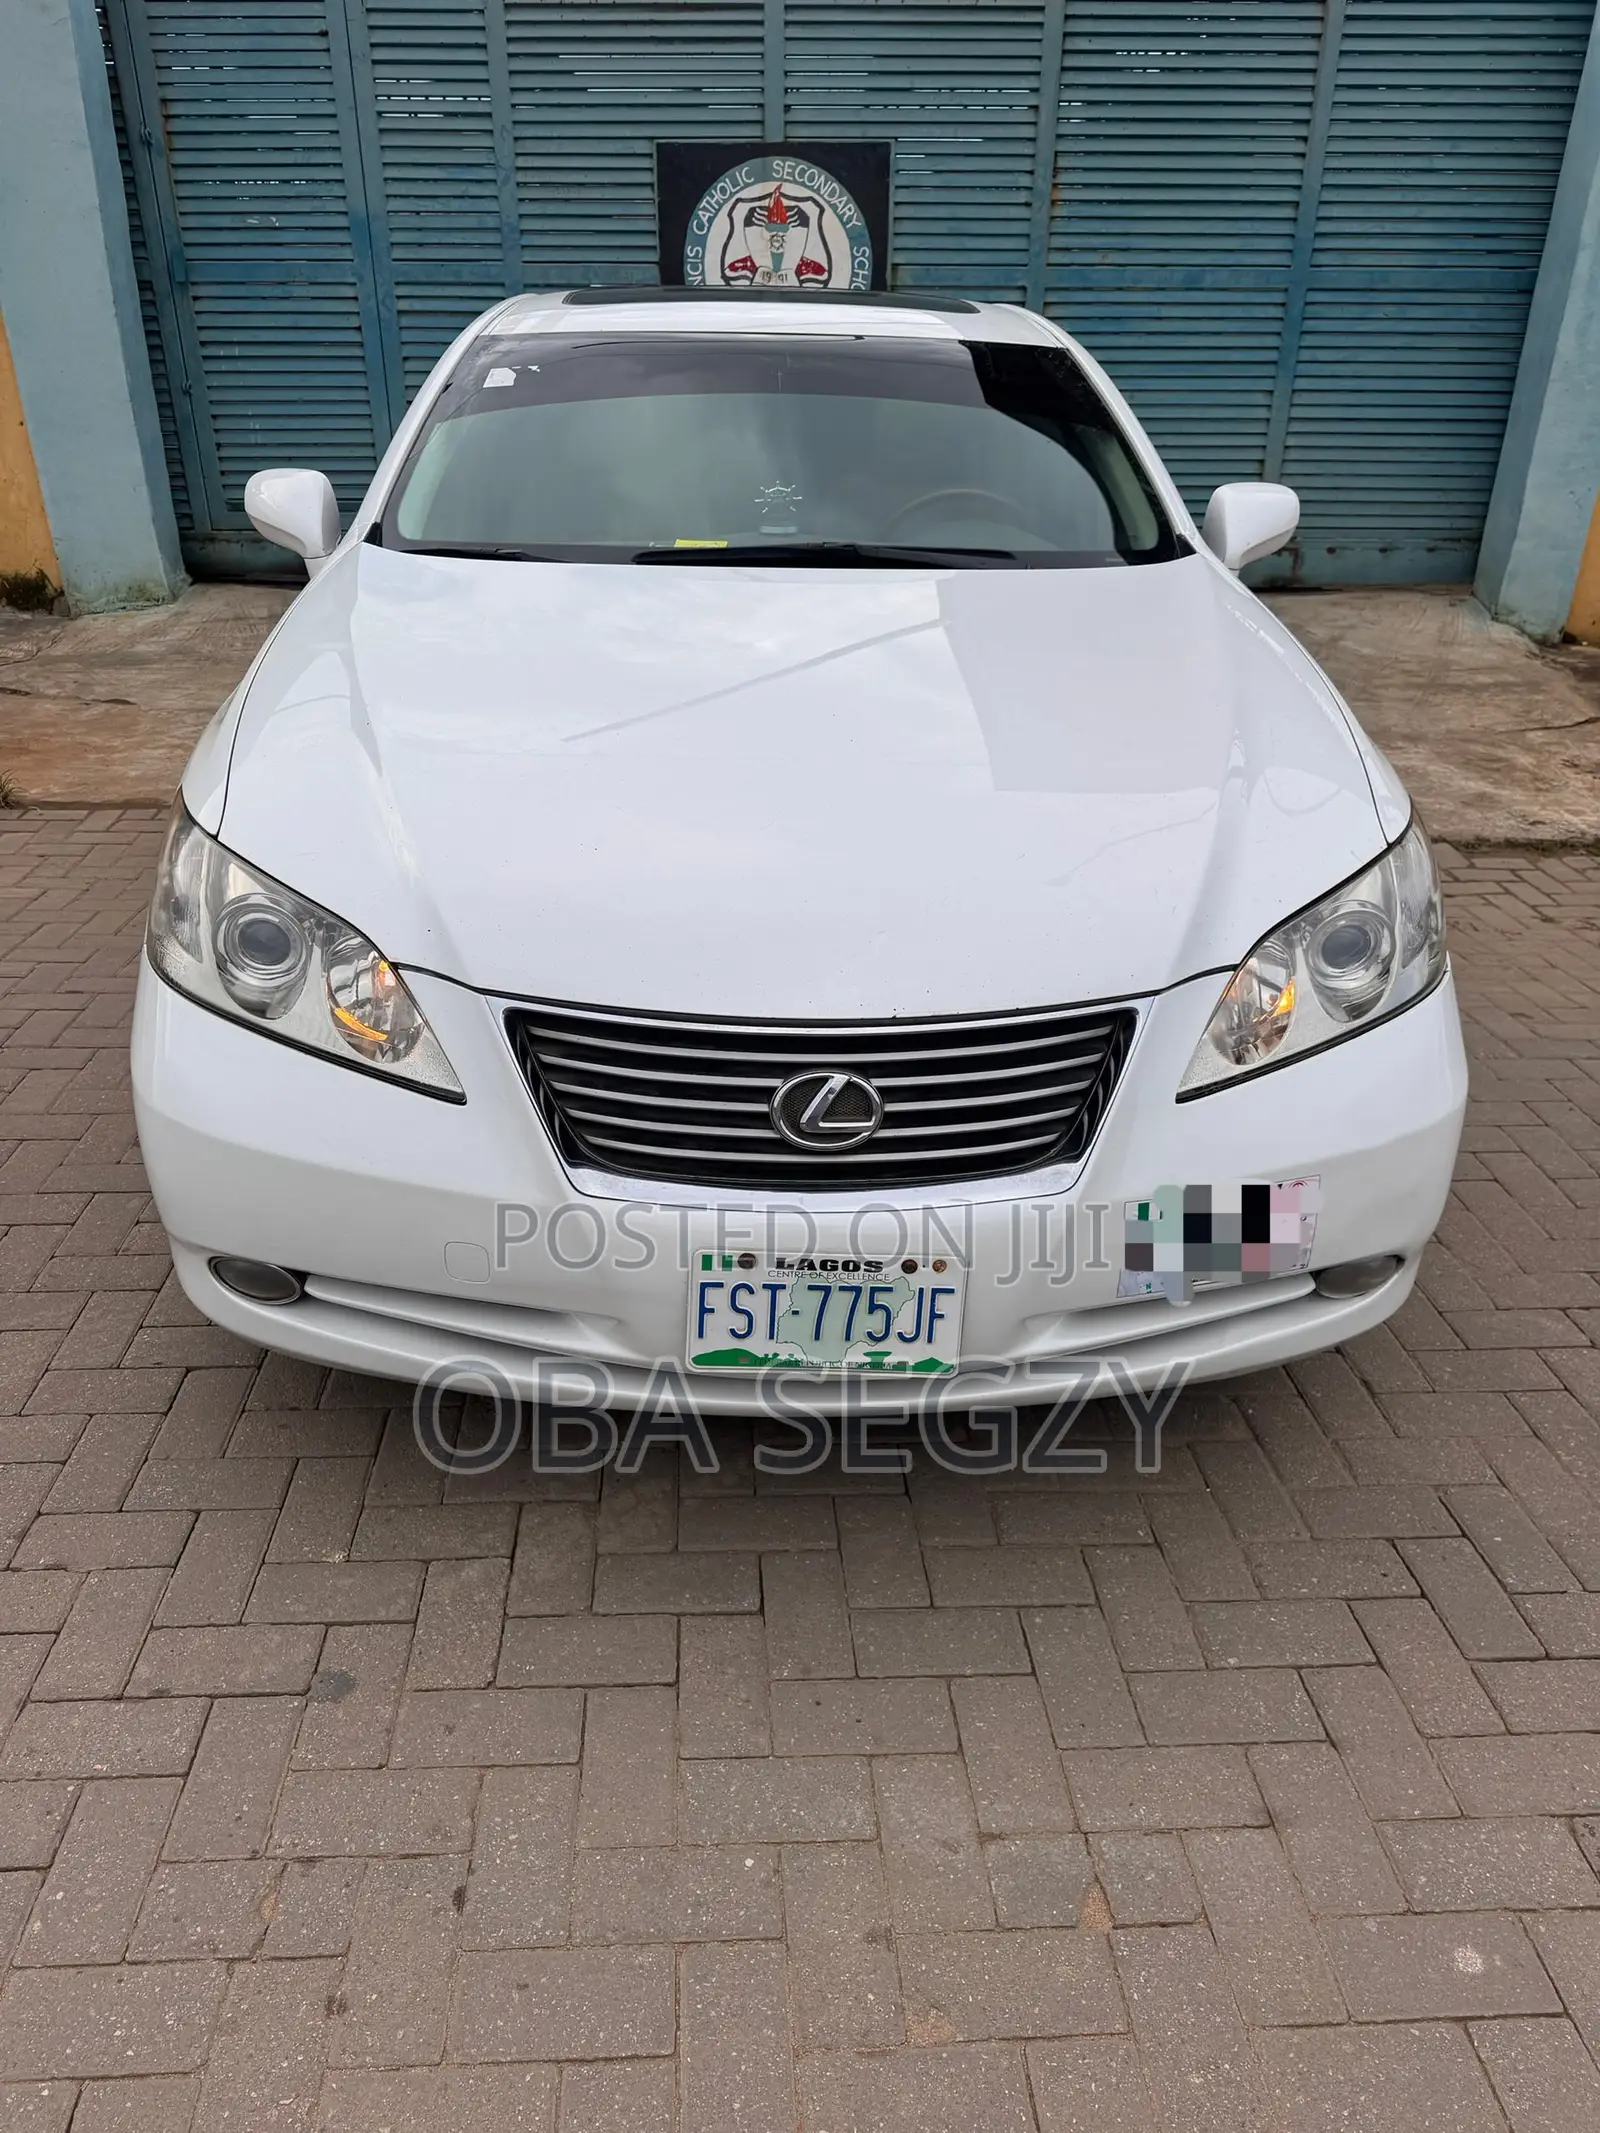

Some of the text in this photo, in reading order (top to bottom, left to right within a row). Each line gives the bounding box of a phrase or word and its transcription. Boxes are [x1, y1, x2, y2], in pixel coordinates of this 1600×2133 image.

[693, 166, 755, 235] CATHOLIC
[772, 160, 862, 229] SECONDARY
[767, 1270, 890, 1281] CENTRE OF EXCELLENCE
[775, 1257, 884, 1273] LAGOS
[697, 1281, 956, 1344] FST-775JF
